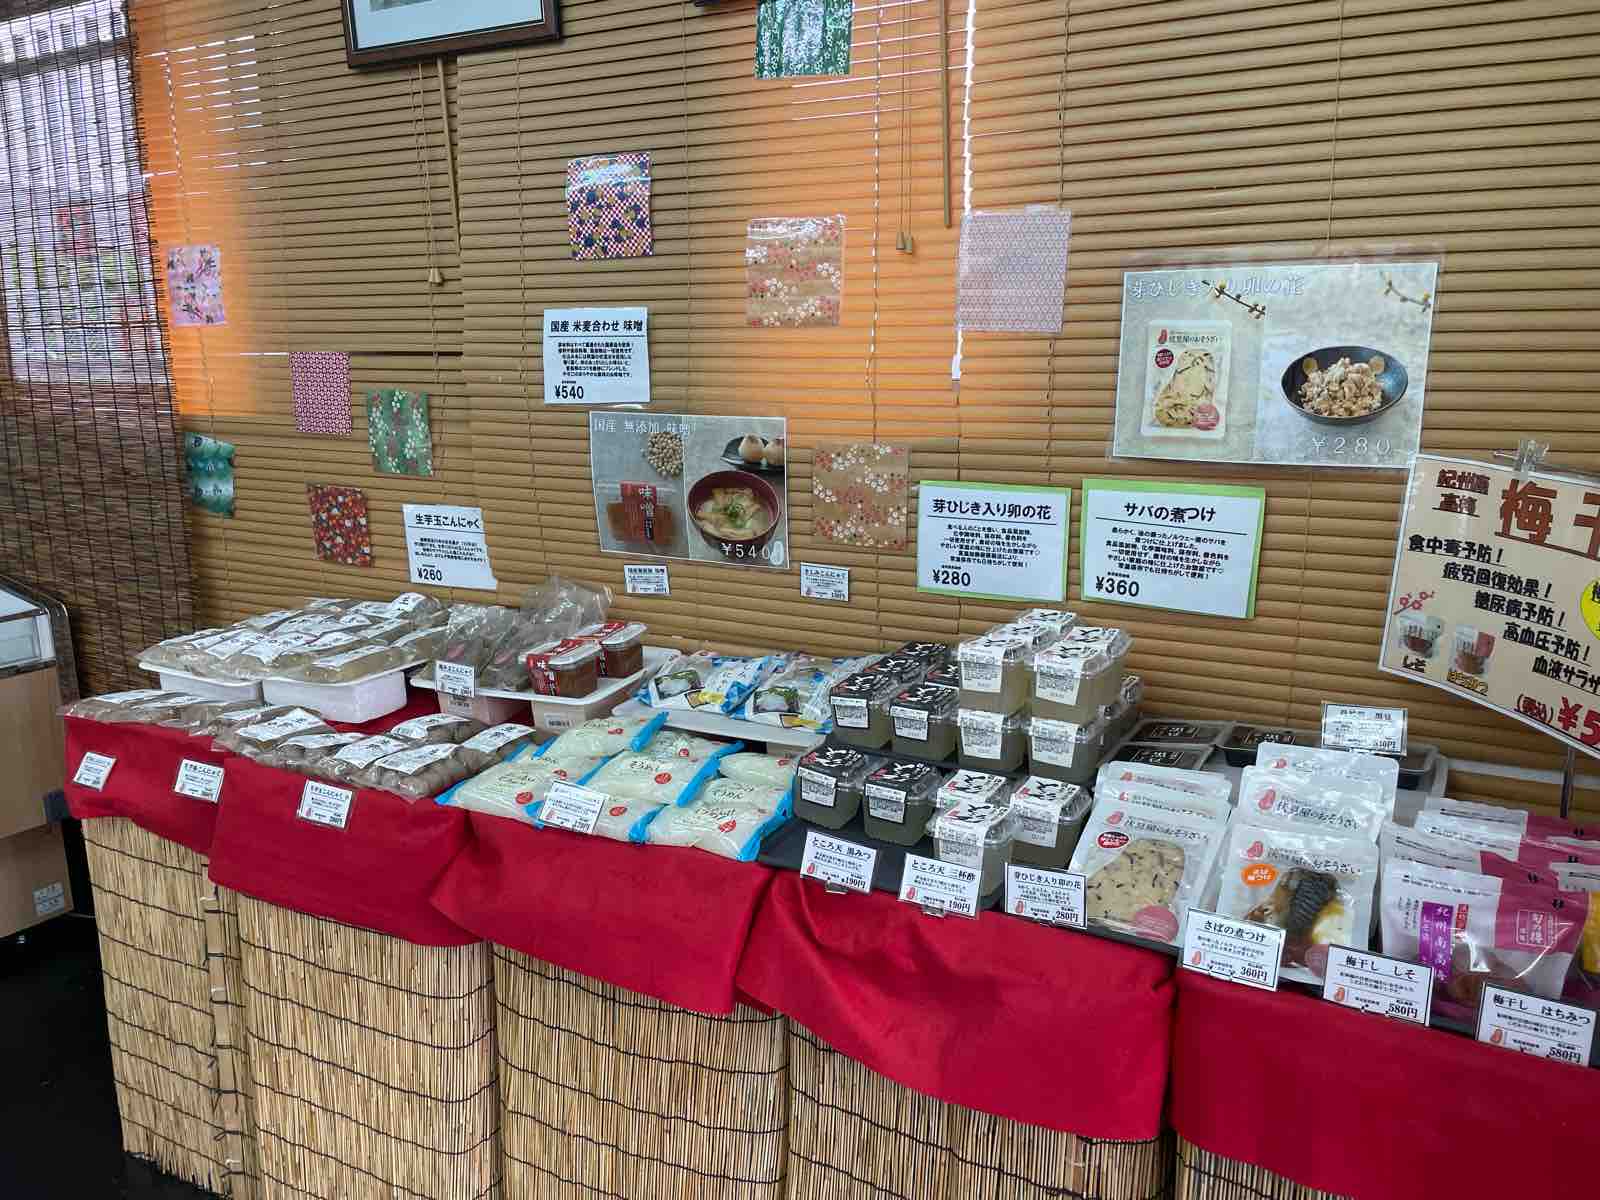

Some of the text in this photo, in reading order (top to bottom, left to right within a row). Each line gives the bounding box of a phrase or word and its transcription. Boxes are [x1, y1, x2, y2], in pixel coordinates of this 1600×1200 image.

[551, 320, 569, 332] 国産
[572, 320, 620, 332] 米麦合わせ
[555, 385, 584, 399] ¥540
[933, 499, 1051, 520] 芽ひじき入り卵の花
[1124, 502, 1216, 524] サバの煮つけ
[415, 512, 480, 529] 生芋玉こんにゃく
[417, 567, 442, 581] ¥260
[932, 569, 971, 586] ¥280
[1096, 576, 1140, 597] ¥360
[1056, 909, 1079, 924] 280円
[1204, 919, 1267, 943] さばの煮つけ
[1240, 966, 1268, 982] 360円
[1345, 955, 1417, 980] 梅干し しそ
[1388, 1003, 1419, 1019] 580円
[1493, 993, 1591, 1026] 梅干し はちみつ
[1548, 1046, 1581, 1064] 580円
